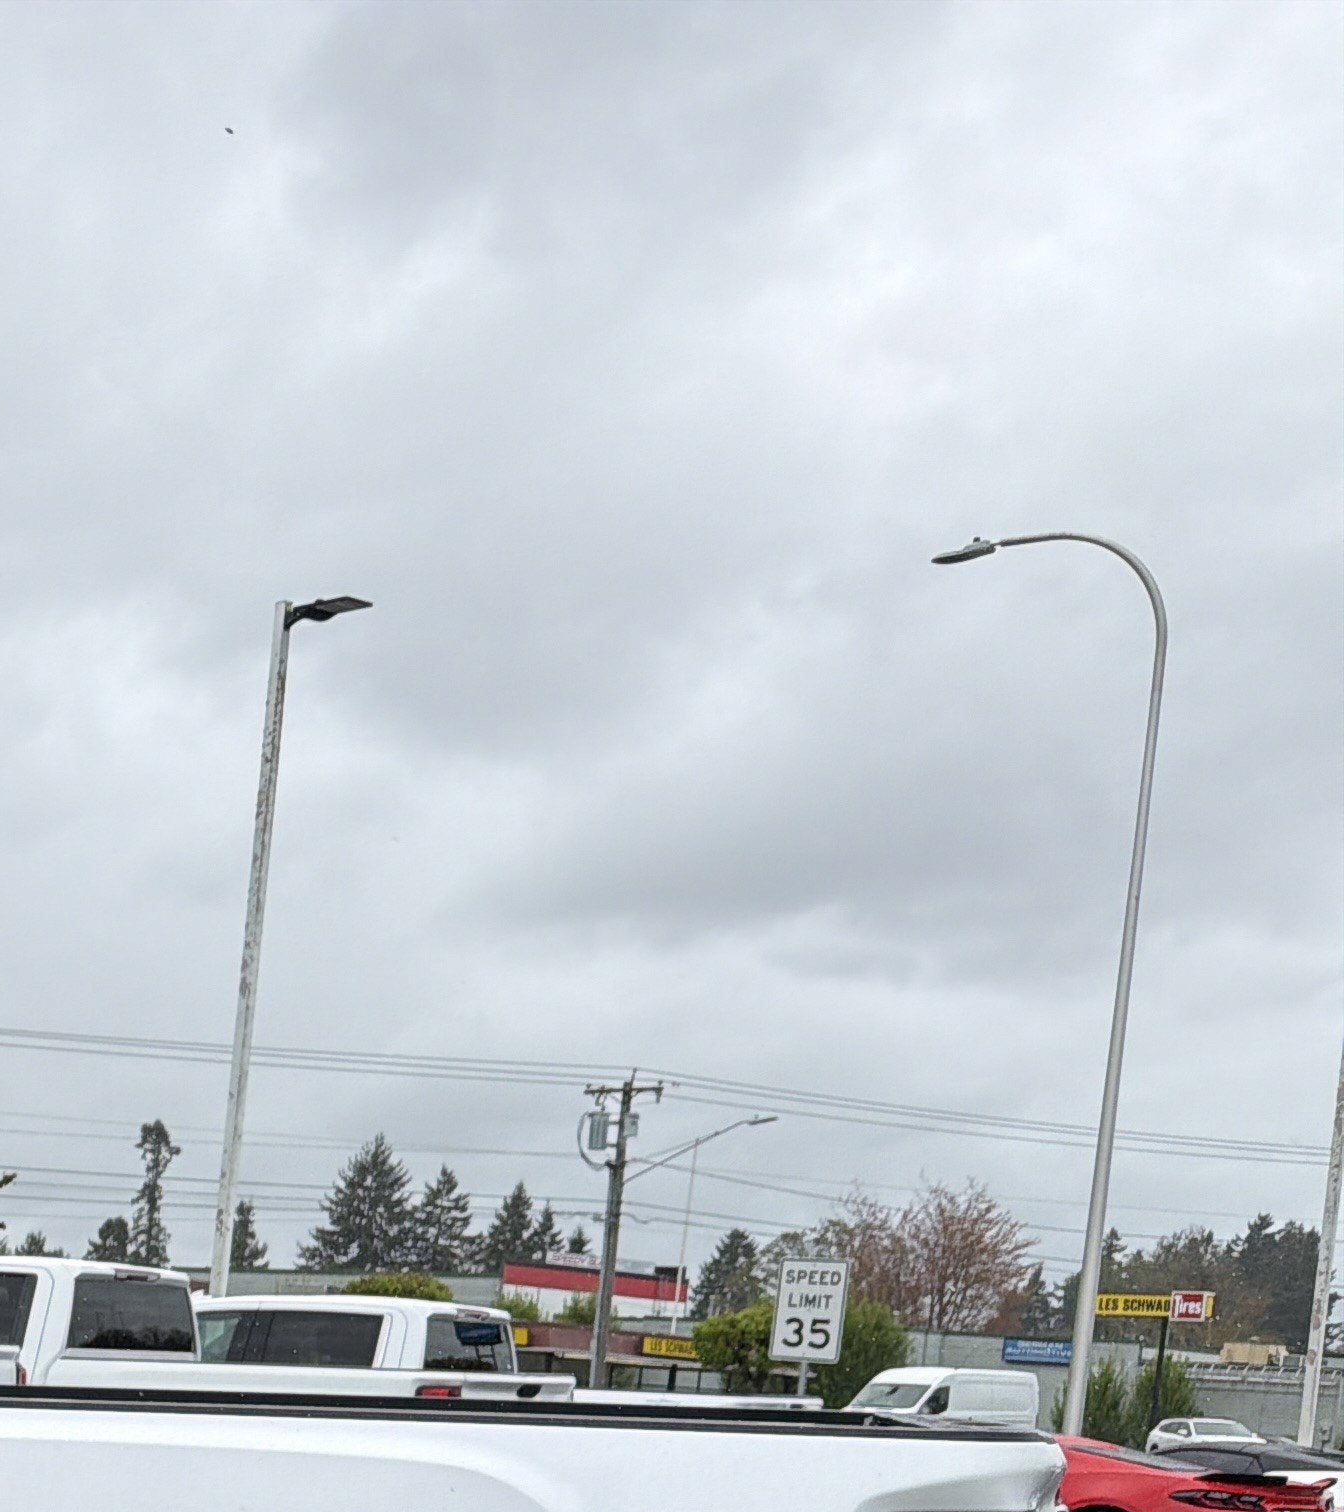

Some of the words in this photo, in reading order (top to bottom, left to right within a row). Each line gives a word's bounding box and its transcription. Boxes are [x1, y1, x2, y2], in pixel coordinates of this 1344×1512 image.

[785, 1269, 841, 1286] SPEED
[788, 1292, 833, 1309] LIMIT
[1098, 1298, 1119, 1311] LES
[1174, 1294, 1202, 1318] Tires
[782, 1317, 830, 1349] 35
